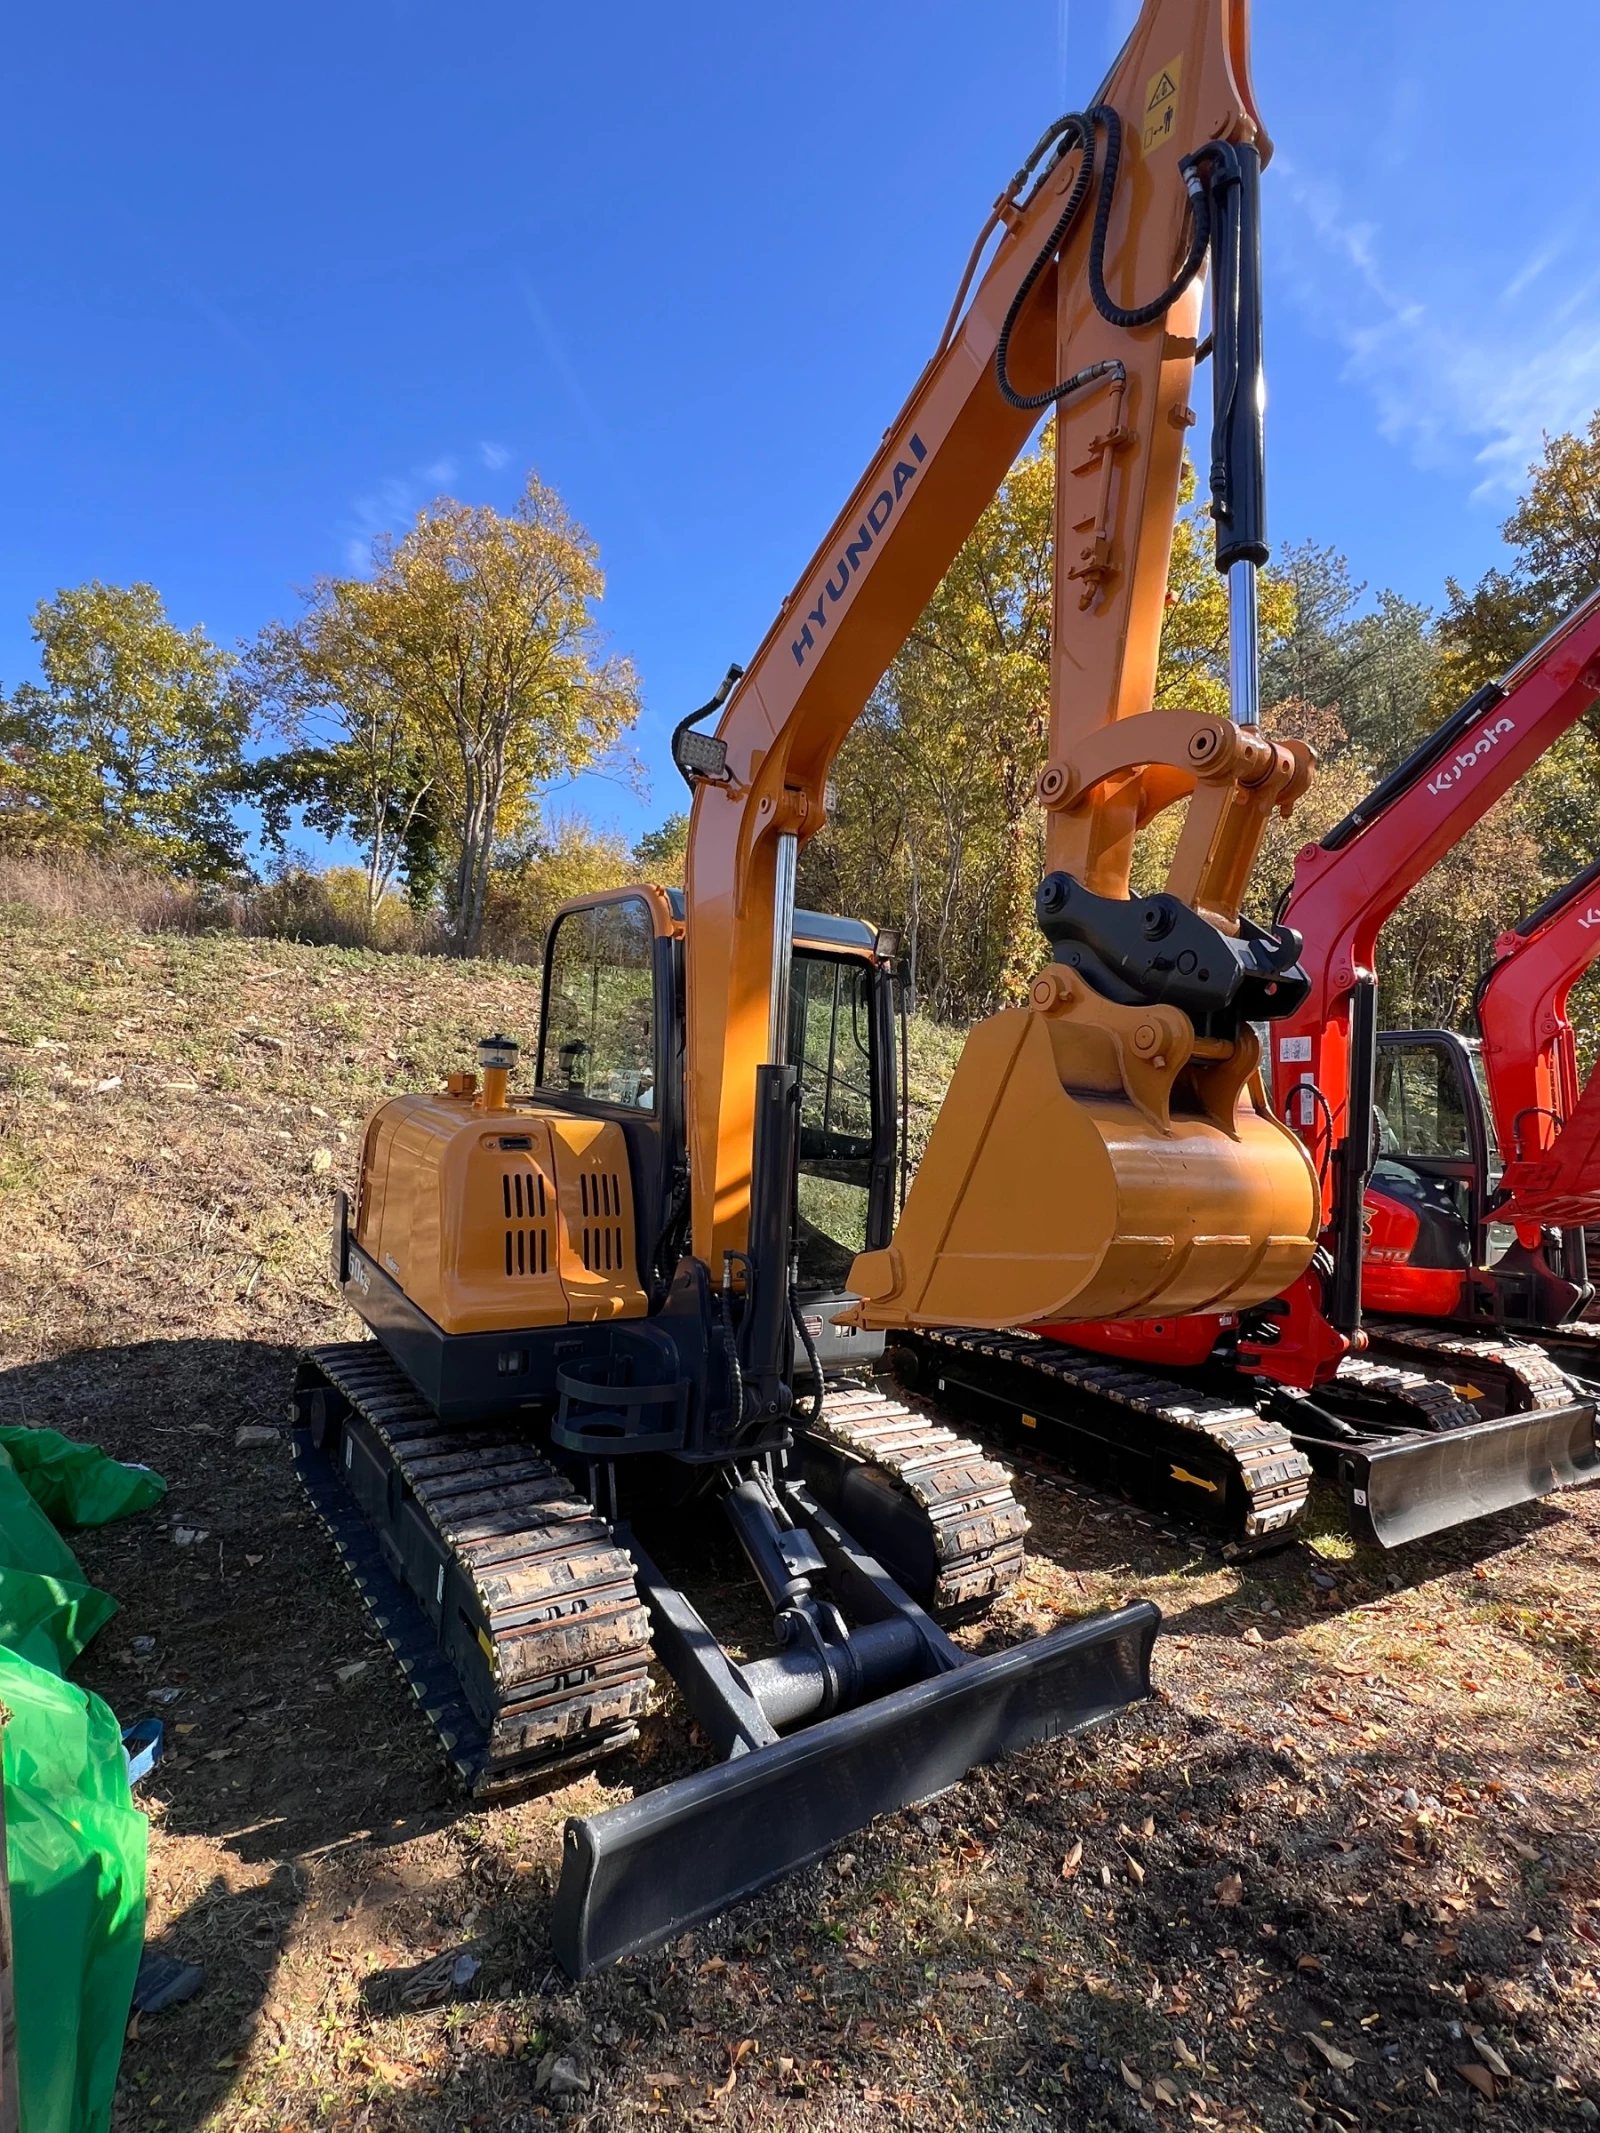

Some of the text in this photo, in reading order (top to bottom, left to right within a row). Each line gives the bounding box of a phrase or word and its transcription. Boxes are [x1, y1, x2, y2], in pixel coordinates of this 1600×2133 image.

[791, 432, 928, 668] HYUNDAI
[1427, 718, 1516, 795] Kubota
[1577, 907, 1600, 929] K
